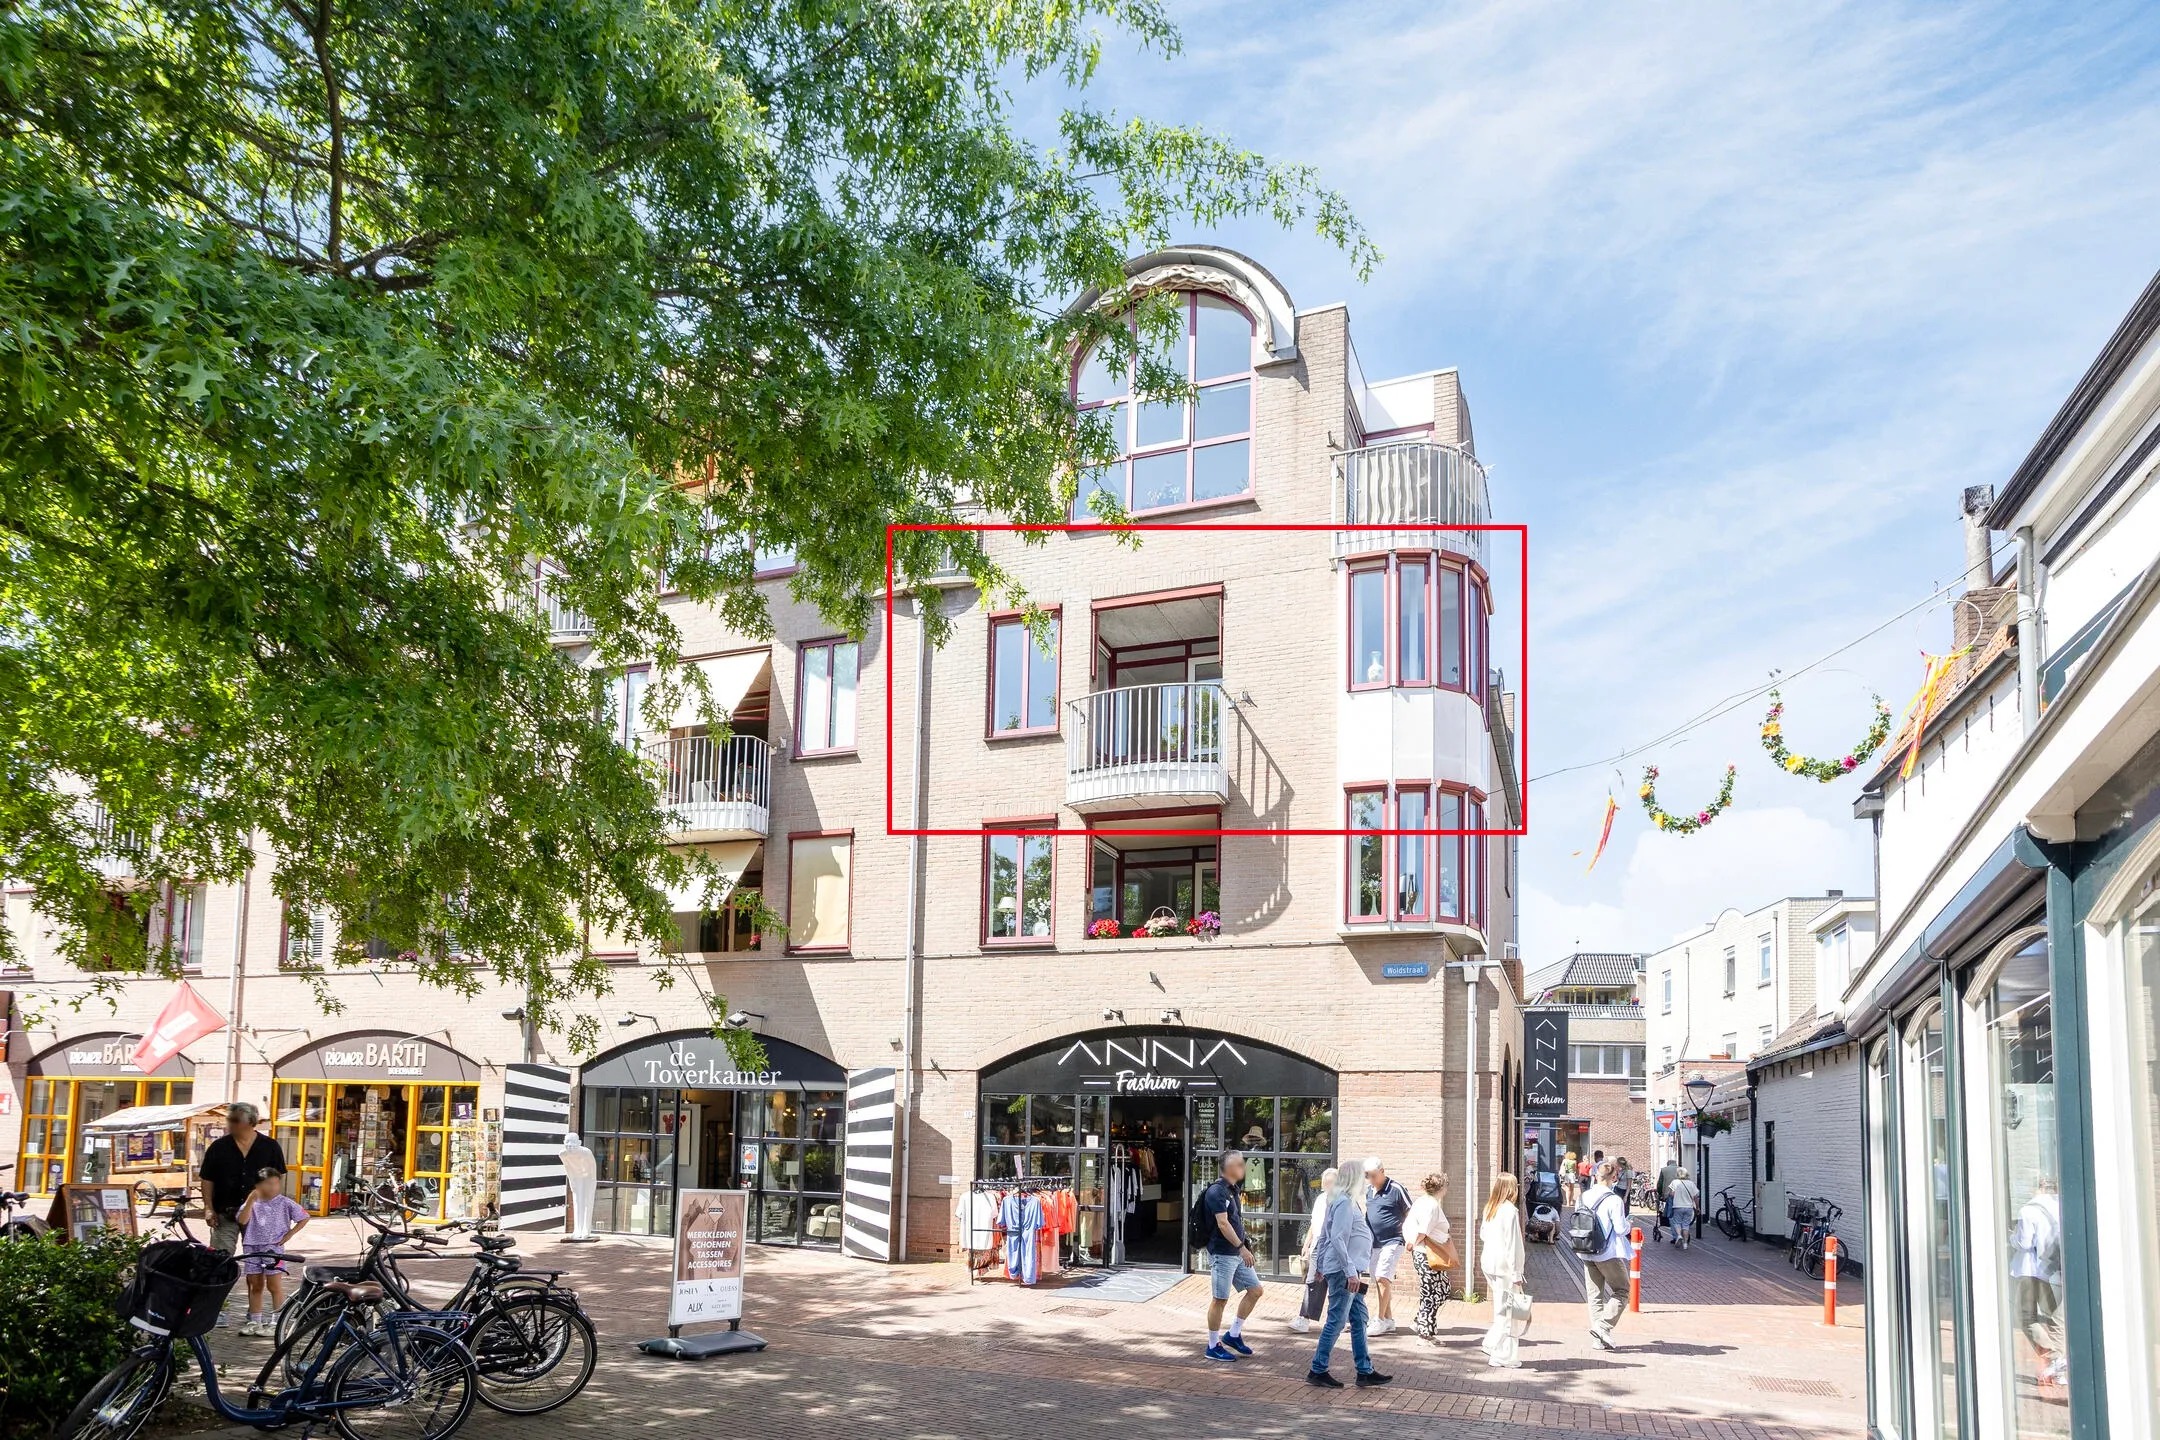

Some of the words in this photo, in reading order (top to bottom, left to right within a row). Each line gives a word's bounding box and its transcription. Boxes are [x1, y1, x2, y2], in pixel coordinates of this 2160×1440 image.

[1387, 966, 1424, 975] Woldstraat
[365, 1043, 427, 1068] BARTH
[669, 1042, 697, 1067] de
[1058, 1038, 1248, 1068] ANNA
[1535, 1018, 1558, 1088] ANNA
[644, 1060, 782, 1086] Toverkamer
[1115, 1070, 1181, 1092] Fashion
[1527, 1092, 1566, 1105] Fashion
[687, 1230, 737, 1240] MERKKLEDING
[691, 1241, 731, 1249] SCHOENEN
[696, 1250, 724, 1259] TASSEN
[688, 1260, 732, 1270] ACCESSOIRES
